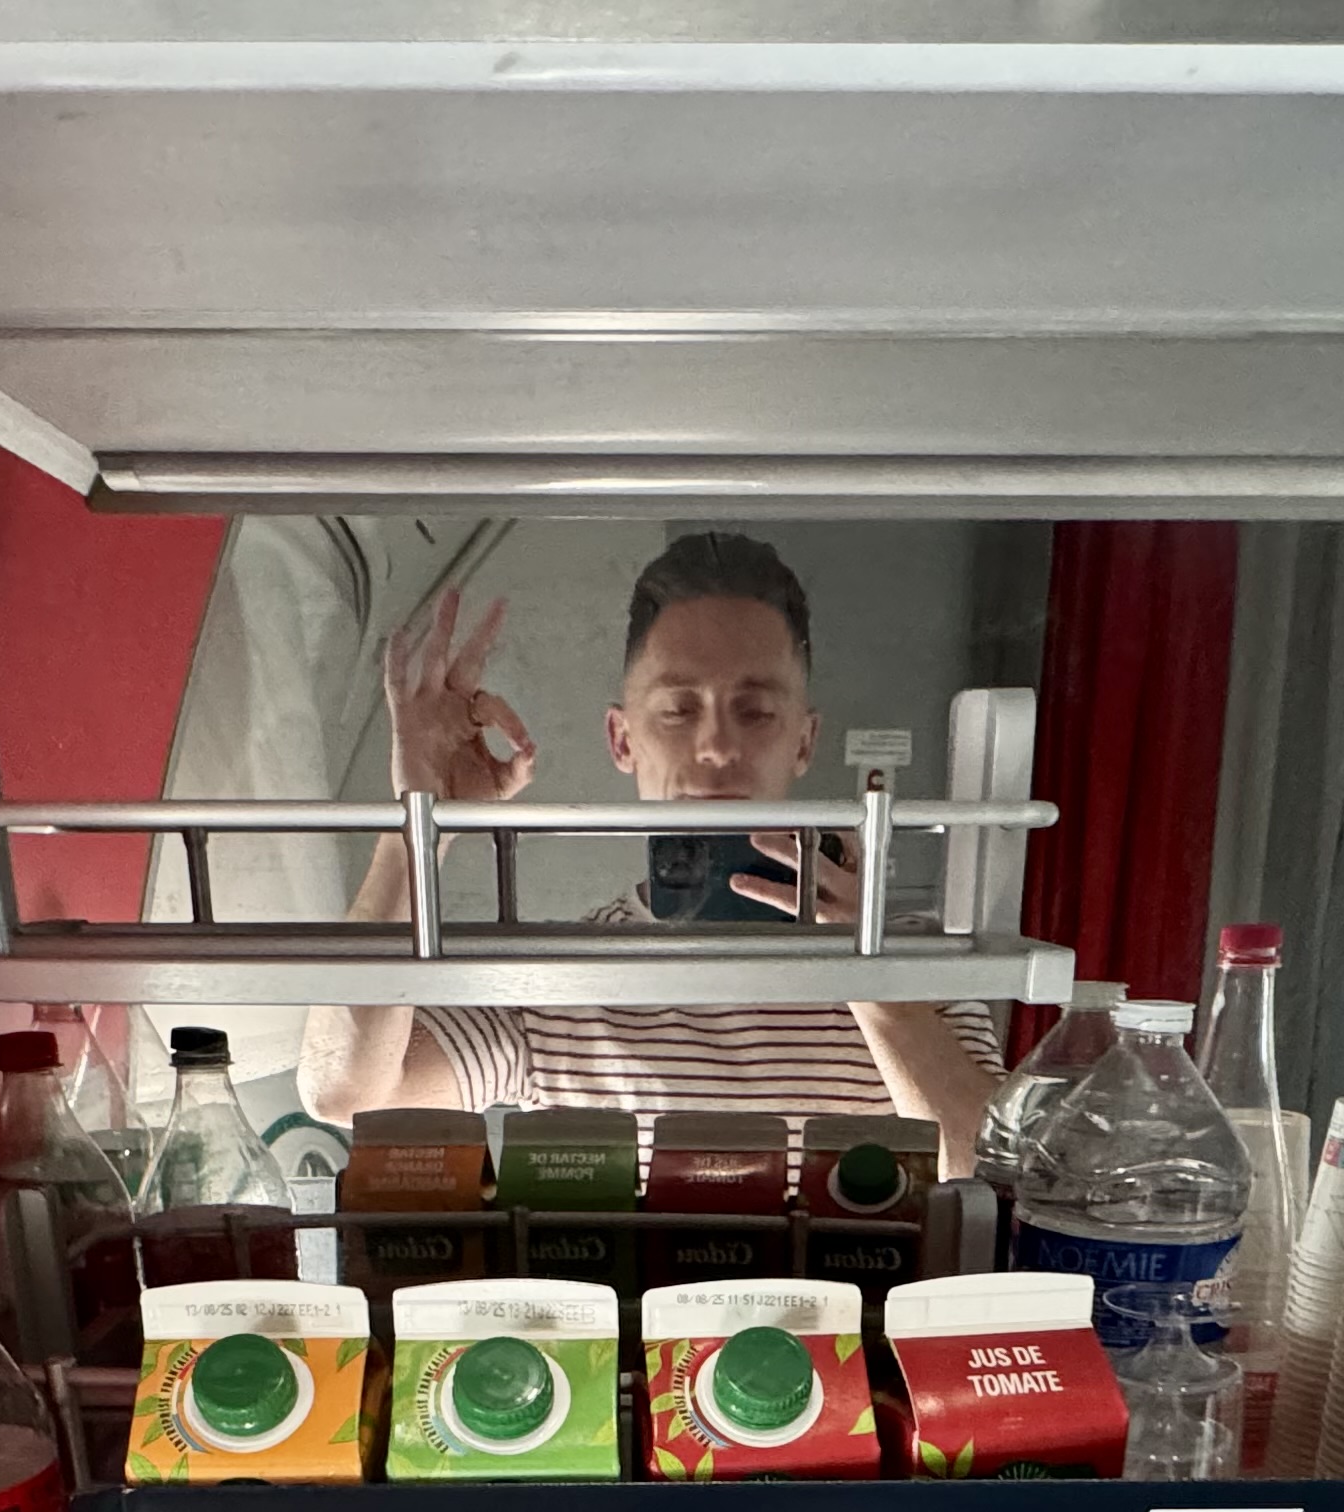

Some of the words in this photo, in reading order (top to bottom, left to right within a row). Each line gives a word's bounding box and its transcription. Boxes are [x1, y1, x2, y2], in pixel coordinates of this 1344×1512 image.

[160, 1347, 199, 1394] FRANÇAISE
[418, 1347, 452, 1396] FRANÇAISE
[673, 1345, 699, 1390] FRANÇAISE
[968, 1347, 1012, 1369] JUS
[1011, 1345, 1046, 1366] DE
[967, 1370, 1064, 1397] TOMATE
[157, 1396, 188, 1453] ENTREPRISE
[416, 1399, 449, 1454] ENTREPRISE
[673, 1395, 711, 1448] ENTREPRISE
